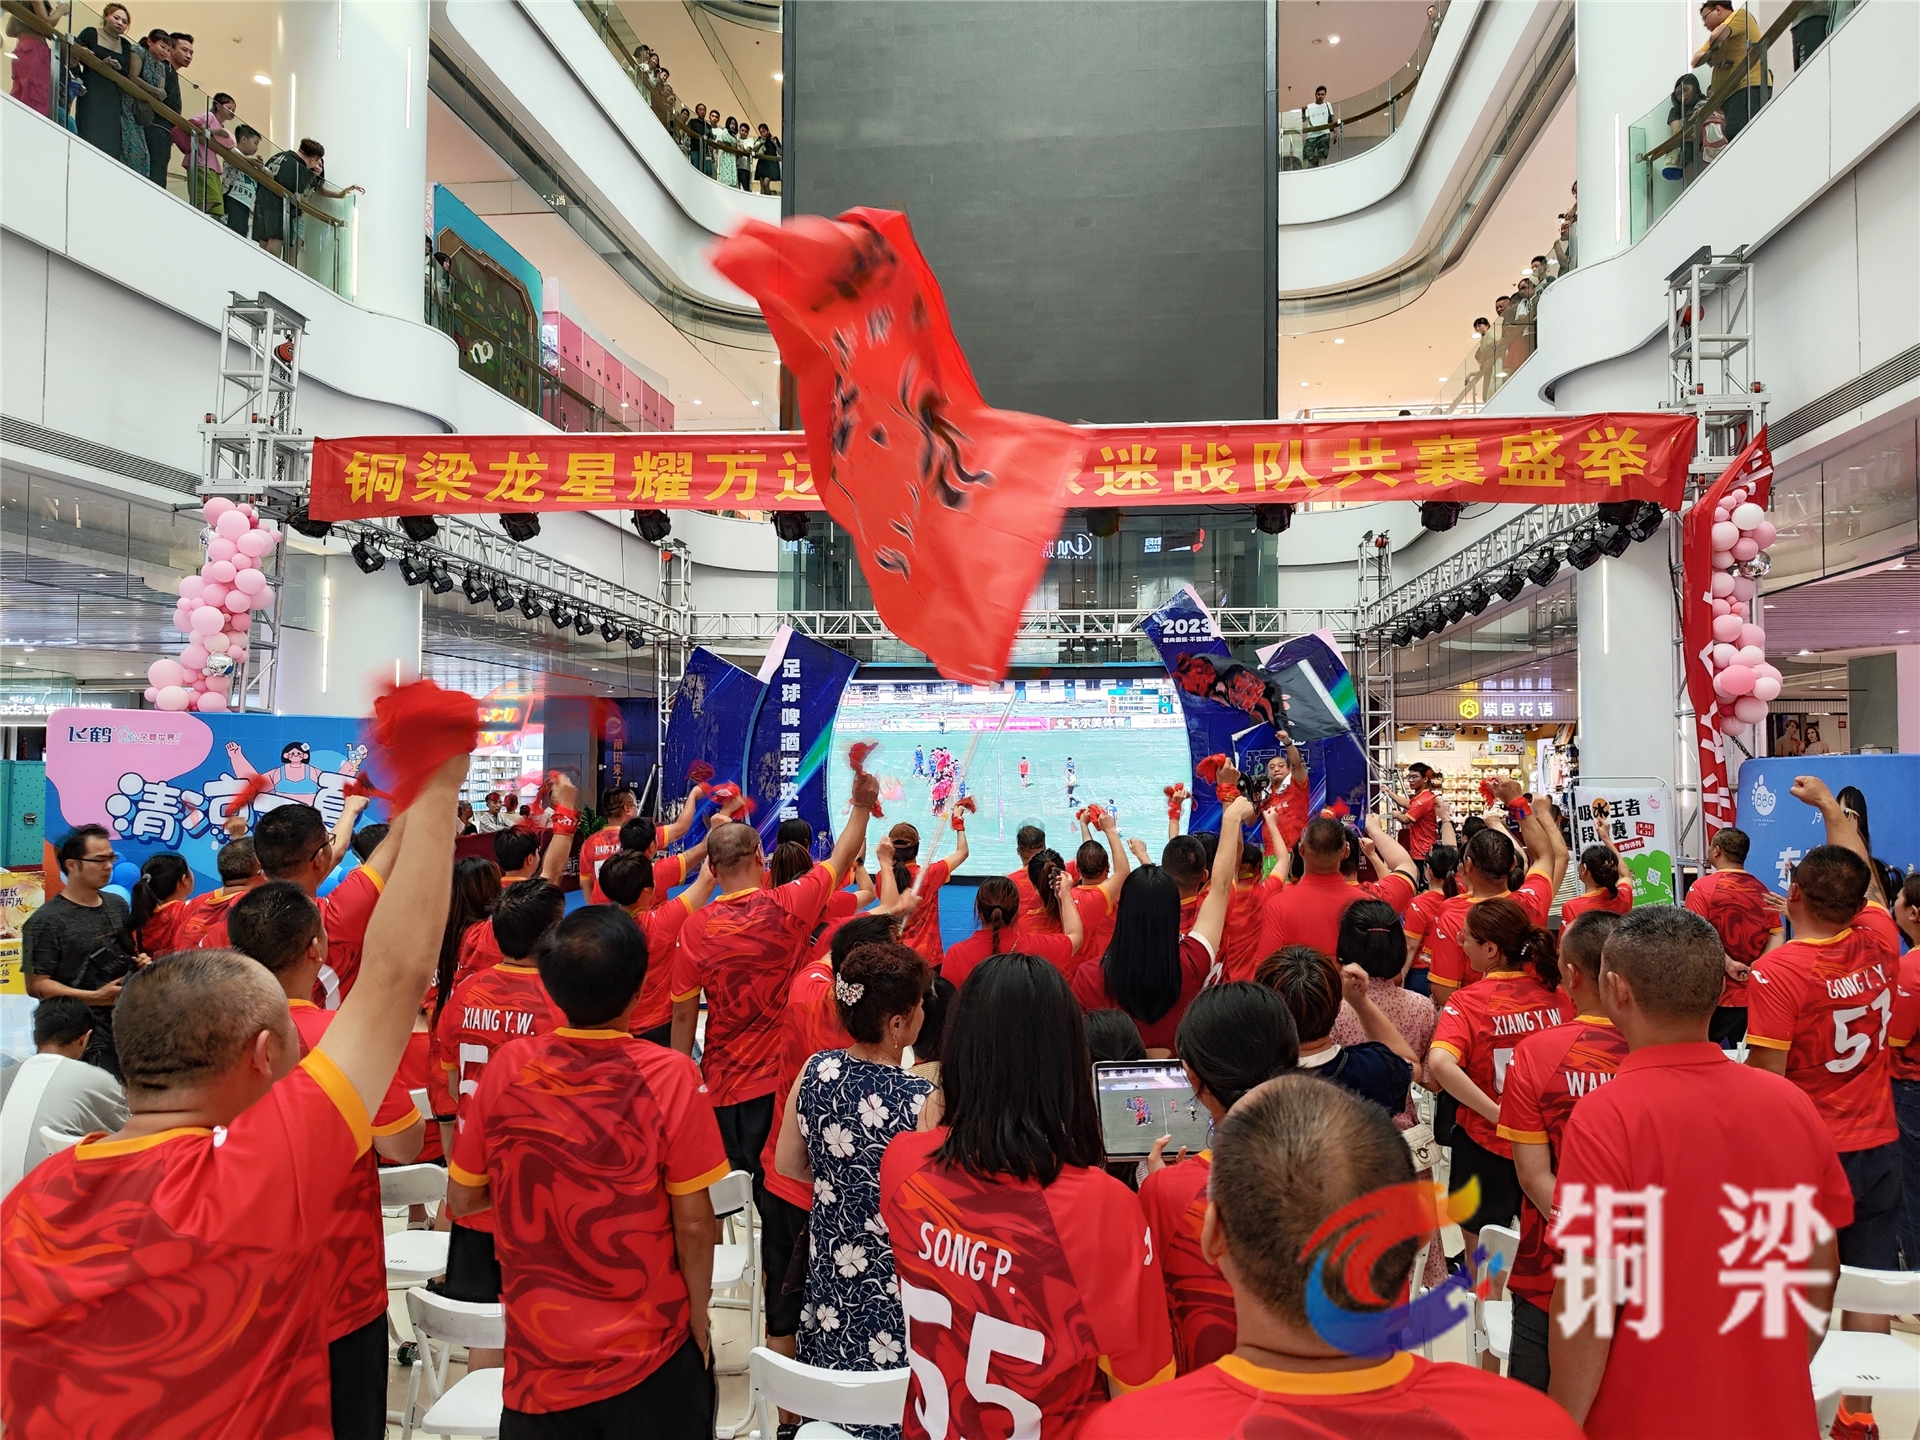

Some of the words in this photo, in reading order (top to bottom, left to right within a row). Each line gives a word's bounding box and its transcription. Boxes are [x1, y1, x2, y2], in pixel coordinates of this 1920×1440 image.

[1162, 618, 1212, 635] 2023
[1482, 701, 1554, 718] 紫色花语
[68, 726, 112, 743] 飞鹤
[1433, 740, 1446, 749] 29
[1503, 744, 1516, 753] 29
[1578, 799, 1641, 821] 吸水王者
[1755, 793, 1775, 808] BBG
[1581, 819, 1629, 844] 段赛
[1826, 972, 1865, 999] GONG
[461, 1007, 500, 1032] XIANG
[504, 1010, 535, 1036] Y.W.
[1492, 1012, 1535, 1036] XIANG
[1565, 1070, 1618, 1098] WAN
[917, 1221, 988, 1282] SONG
[990, 1247, 1017, 1296] P.
